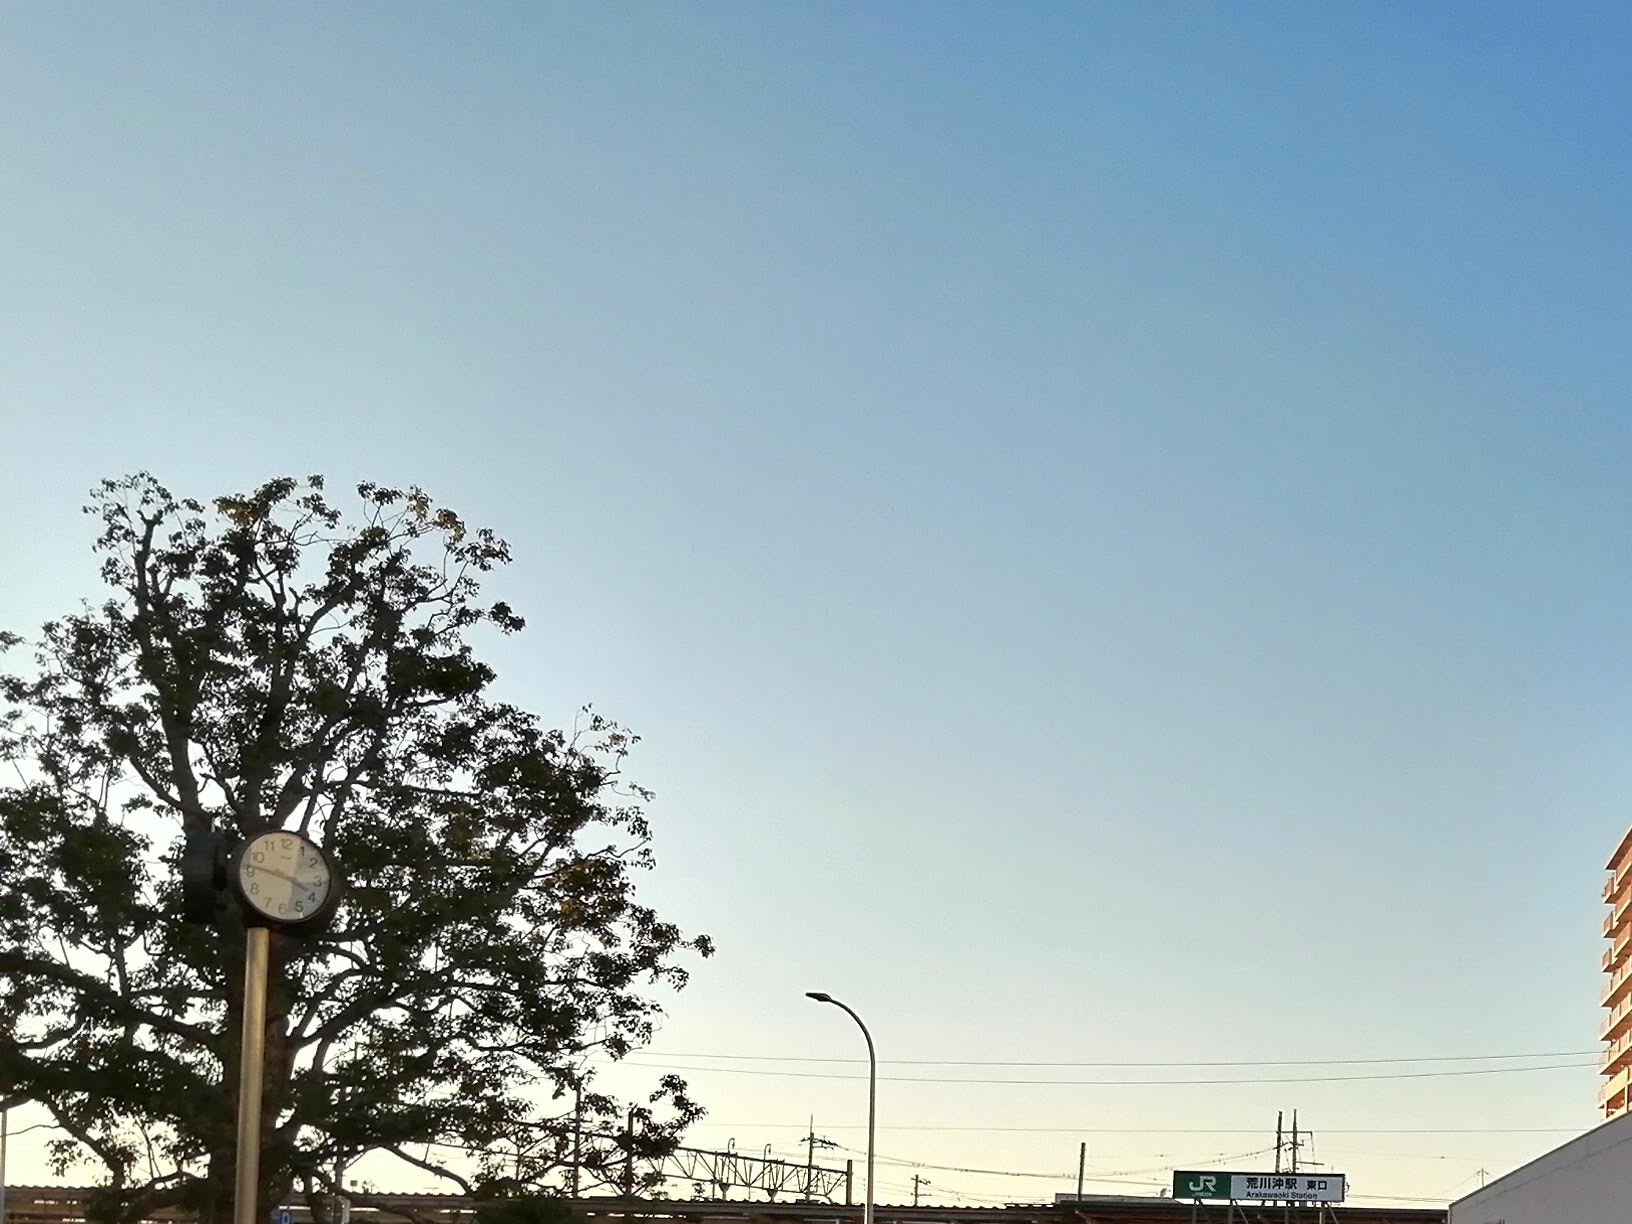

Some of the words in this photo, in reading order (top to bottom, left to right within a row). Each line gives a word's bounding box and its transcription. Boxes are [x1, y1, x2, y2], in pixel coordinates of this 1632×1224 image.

[264, 840, 275, 852] 11
[281, 838, 293, 850] 12
[251, 851, 265, 863] 10
[300, 846, 305, 857] 1
[309, 857, 318, 869] 2
[246, 864, 255, 878] 9
[313, 875, 322, 887] 3
[250, 882, 260, 895] 8
[264, 897, 272, 908] 7
[307, 891, 316, 903] 4
[278, 903, 287, 915] 6
[295, 901, 304, 912] 5
[1188, 1175, 1217, 1192] JR
[1246, 1177, 1297, 1190] 荒川沖駅
[1306, 1180, 1328, 1191] 東口
[1246, 1191, 1289, 1199] Arakawaoki
[1290, 1191, 1318, 1200] Station
